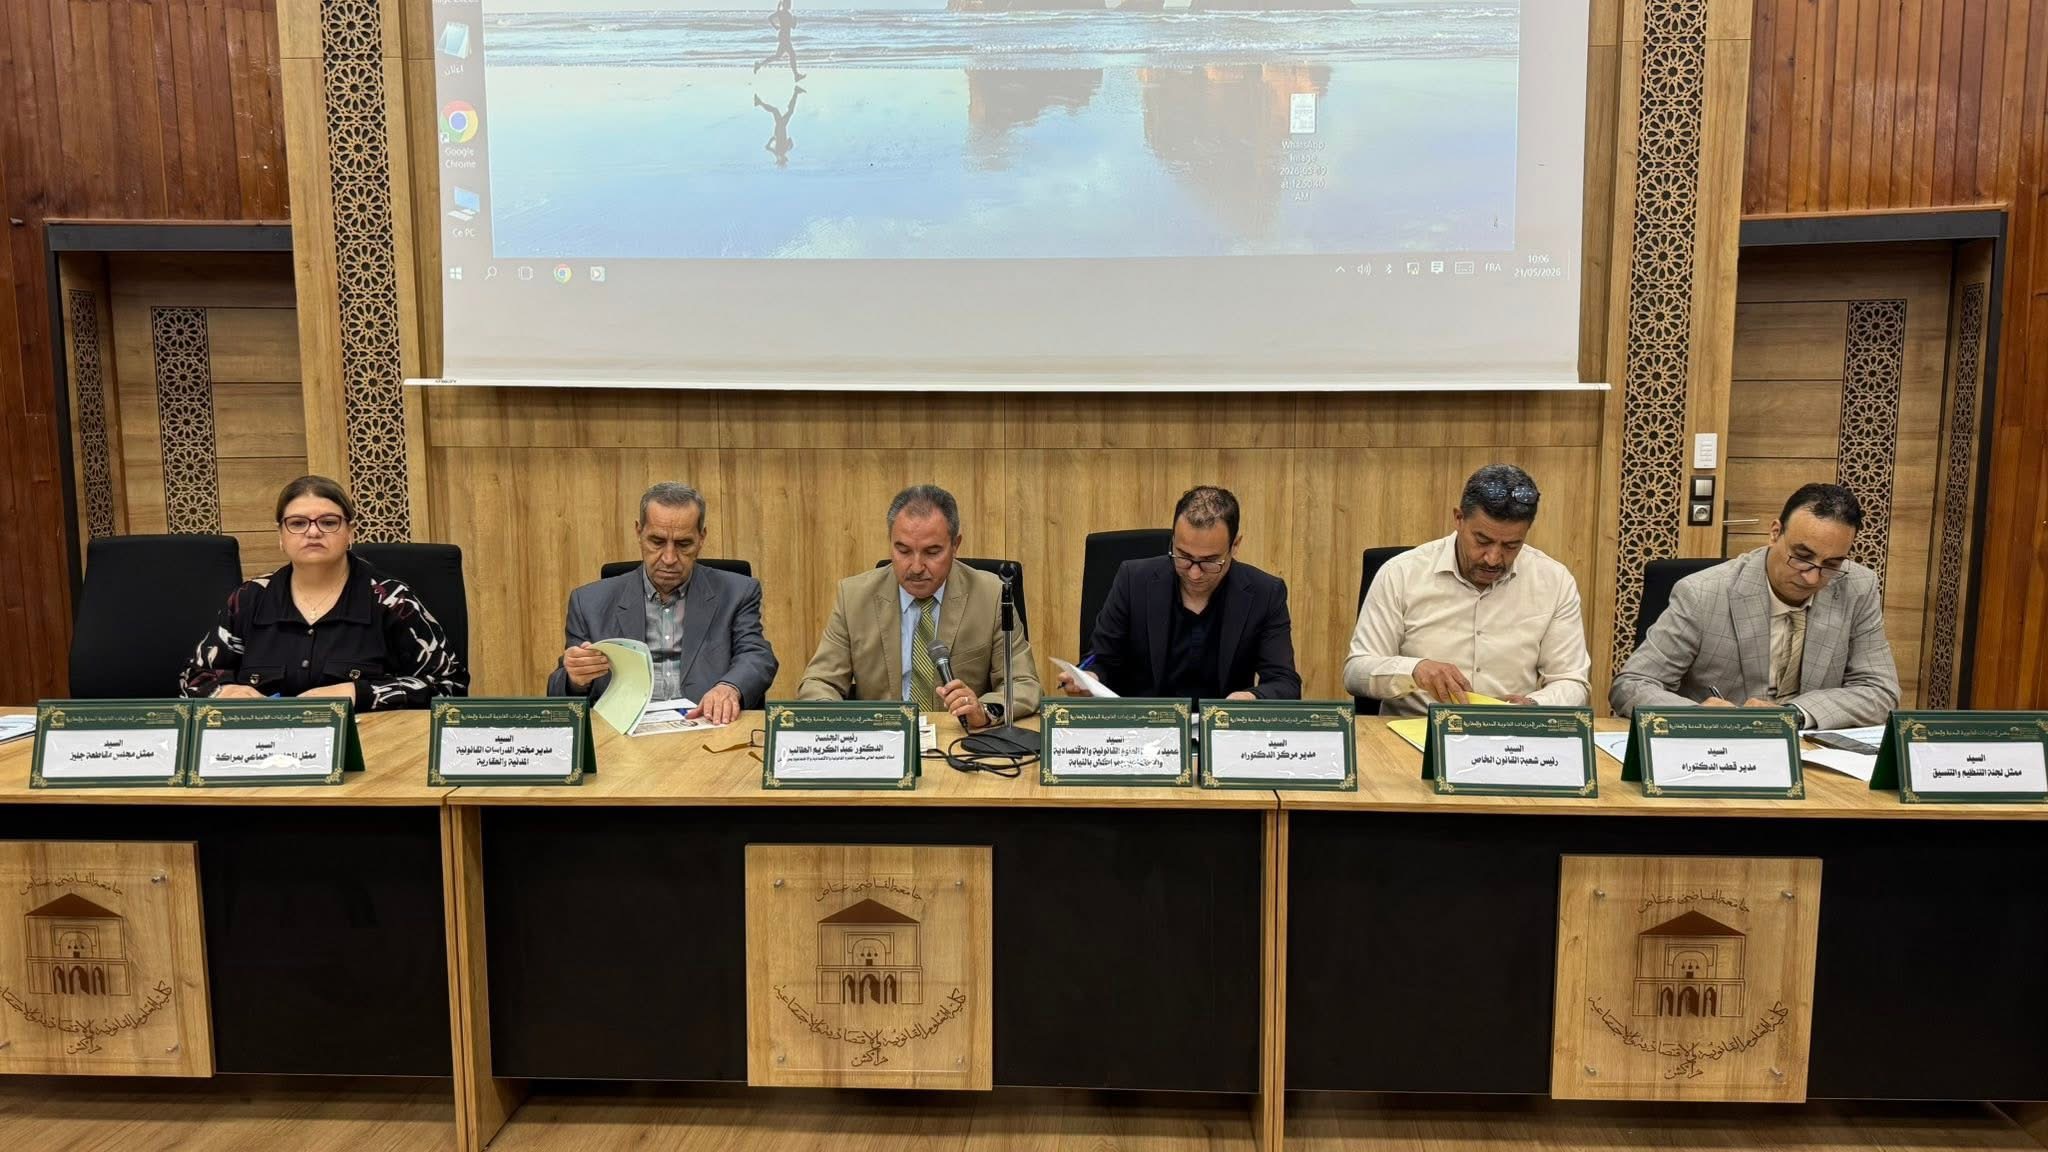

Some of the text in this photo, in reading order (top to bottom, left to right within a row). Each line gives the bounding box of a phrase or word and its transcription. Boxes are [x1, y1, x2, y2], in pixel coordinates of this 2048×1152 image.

[444, 147, 475, 158] Google
[444, 159, 477, 169] Chrome
[452, 227, 476, 238] Ce PC
[1528, 254, 1550, 264] 10:06
[1485, 262, 1502, 273] FRA
[1514, 267, 1561, 278] 21/05/2026
[494, 735, 513, 744] السيد
[815, 733, 857, 743] رئيس الجلسة
[1106, 736, 1125, 745] السيد
[104, 739, 124, 749] السيد
[255, 741, 275, 751] السيد
[1268, 739, 1287, 749] السيد
[136, 749, 154, 760] ممثل
[456, 745, 552, 756] مدير مختبر الدراسات القانونية
[789, 744, 883, 755] الدكتور عبد الكريم الطالب
[1053, 745, 1092, 756] والاقتصادية
[1504, 745, 1524, 754] السيد
[1707, 747, 1728, 757] السيد
[86, 750, 112, 760] مقاطعة
[113, 751, 135, 761] مجلس
[298, 751, 316, 761] ممثل
[1241, 750, 1316, 761] مدير مركز الدكتوراه
[1966, 754, 1986, 764] السيد
[476, 757, 529, 767] المدنية والعقارية
[1068, 758, 1091, 768] بالنيابة
[1471, 755, 1559, 766] رئيس شعبة القانون الخاص
[1682, 761, 1756, 773] مدير قطب الدكتوراه
[1932, 768, 2022, 778] ممثل لجنة التنظيم والتنسيق
